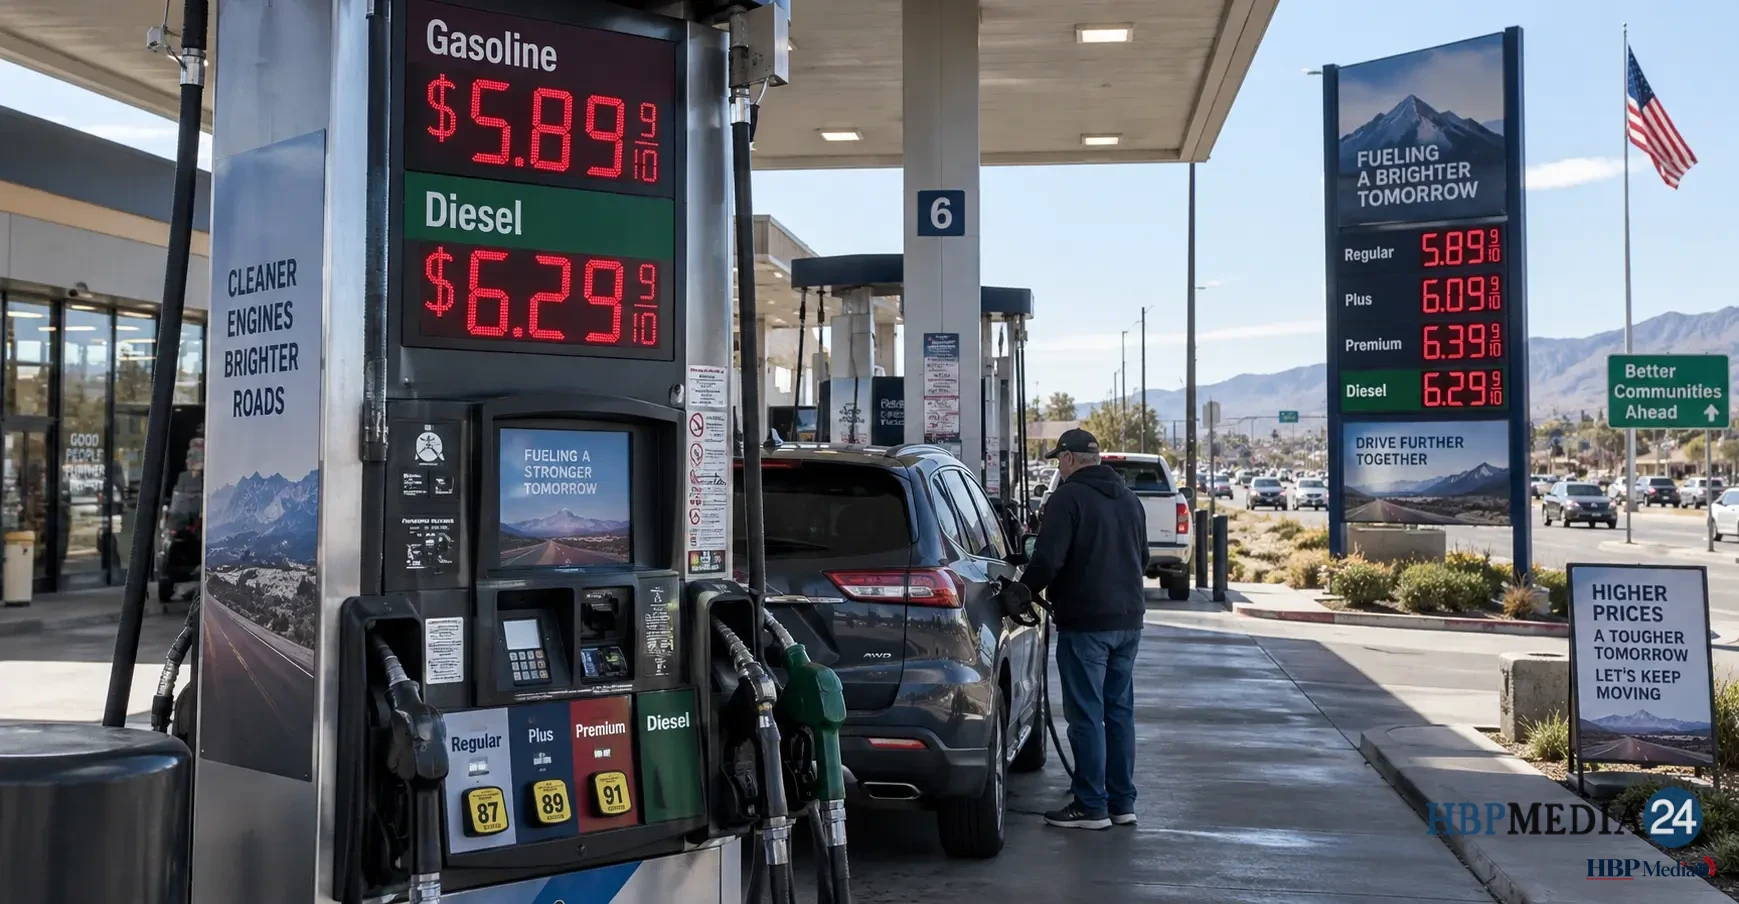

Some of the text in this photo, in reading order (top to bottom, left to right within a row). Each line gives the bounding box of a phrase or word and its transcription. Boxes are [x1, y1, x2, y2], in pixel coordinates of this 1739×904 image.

[427, 18, 557, 72] Gasoline
[426, 74, 625, 178] $5.89
[1357, 144, 1439, 168] FUELING
[1357, 162, 1471, 187] A BRIGHTER
[1357, 181, 1478, 207] TOMORROW
[426, 191, 522, 235] Diesel
[930, 197, 953, 229] 6
[1345, 229, 1484, 267] Regular 5.89
[228, 258, 297, 297] CLEANER
[425, 246, 625, 343] $6.29
[1345, 276, 1485, 314] Plus 6.09
[227, 300, 293, 338] ENGINES
[1345, 323, 1485, 360] Premium 6.39
[224, 342, 299, 378] BRIGHTER
[1625, 364, 1676, 378] Better
[1346, 371, 1486, 407] Diesel 6.29
[1614, 383, 1722, 398] Communities
[233, 386, 285, 418] ROADS
[1625, 404, 1678, 419] Ahead
[70, 433, 99, 447] GOOD
[1356, 436, 1464, 449] DRIVE FURTHER
[524, 448, 591, 462] FUELING A
[1356, 453, 1427, 466] TOGETHER
[524, 465, 592, 478] STRONGER
[523, 482, 597, 495] TOMORROW
[1592, 583, 1668, 602] HIGHER
[1593, 605, 1663, 622] PRICES
[1594, 629, 1685, 645] A TOUGHER
[1594, 646, 1689, 662] TOMORROW
[1595, 667, 1681, 684] LET'S KEEP
[1596, 686, 1661, 701] MOVING
[576, 720, 626, 738] Premium
[647, 712, 690, 732] Diesel
[451, 733, 502, 754] Regular
[529, 728, 554, 743] Plus
[542, 793, 564, 815] 89
[603, 785, 624, 805] 91
[477, 801, 499, 824] 87
